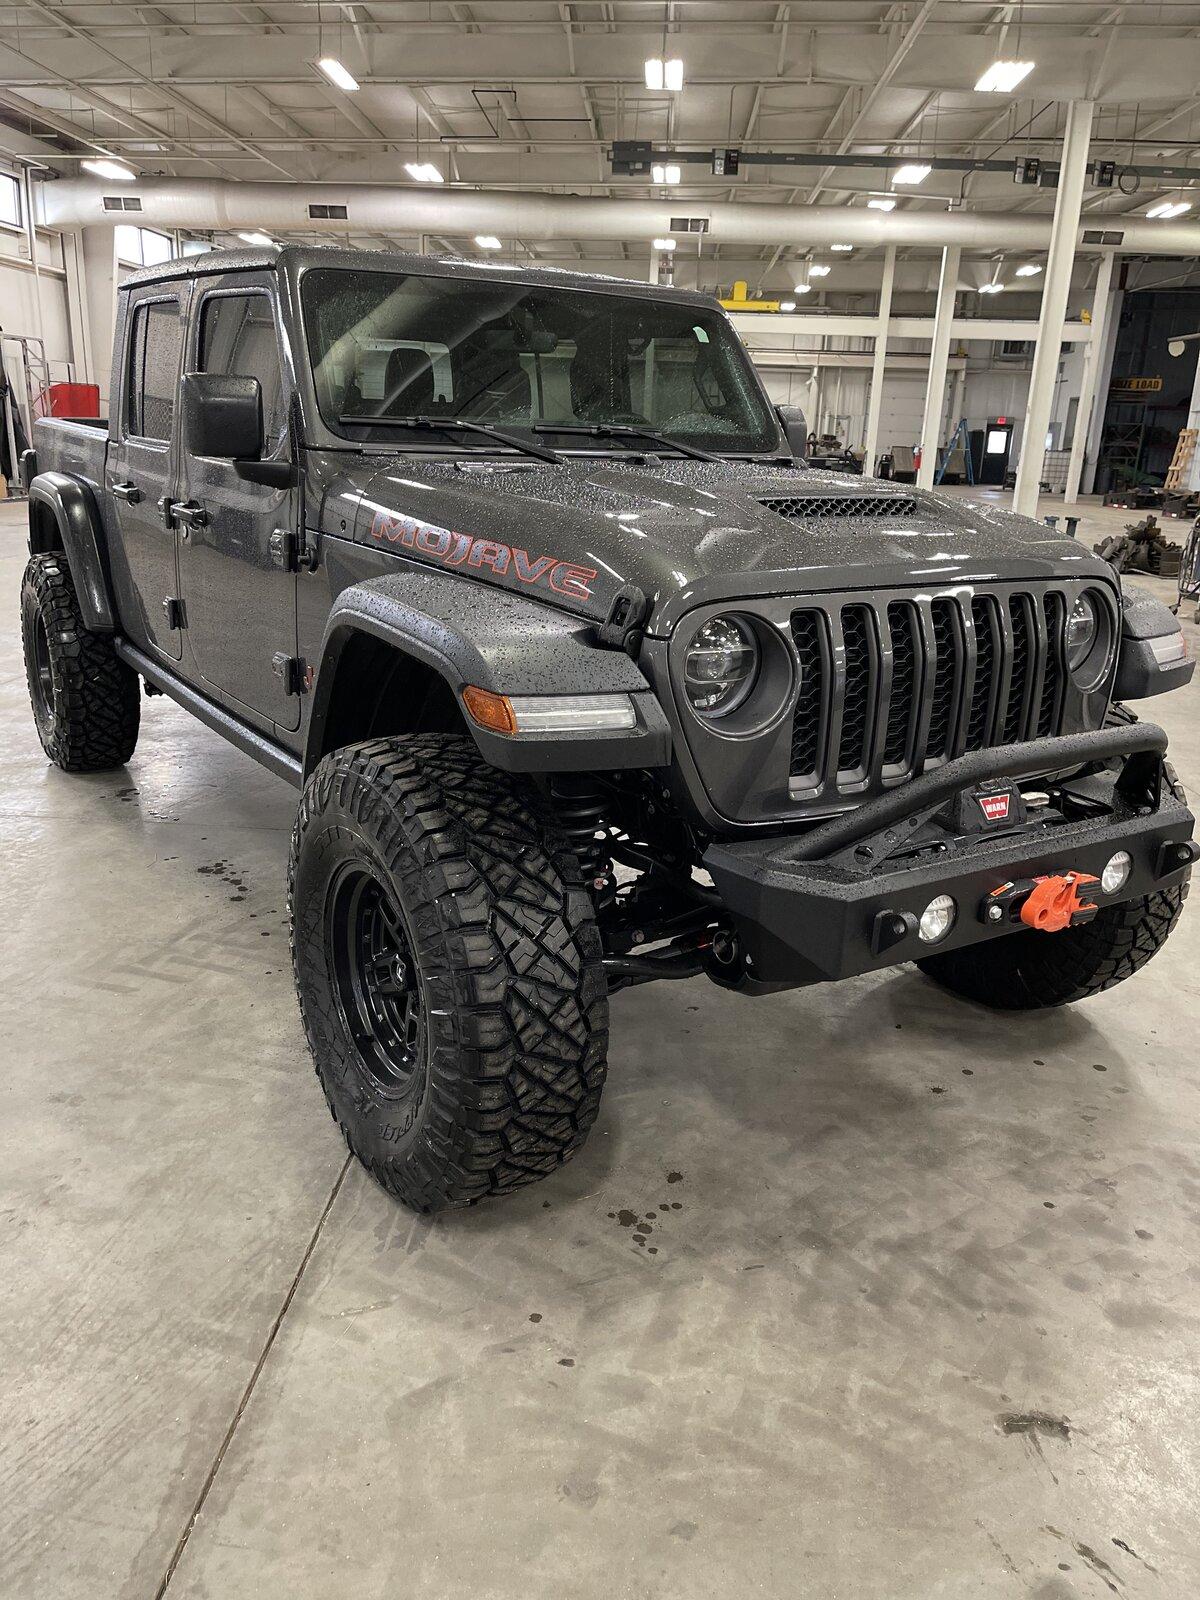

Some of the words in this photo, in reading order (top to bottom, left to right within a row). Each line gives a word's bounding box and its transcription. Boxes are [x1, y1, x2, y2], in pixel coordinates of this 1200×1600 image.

[1136, 380, 1160, 389] LOAD
[371, 510, 597, 600] MOJAVE
[985, 802, 1007, 813] WARN
